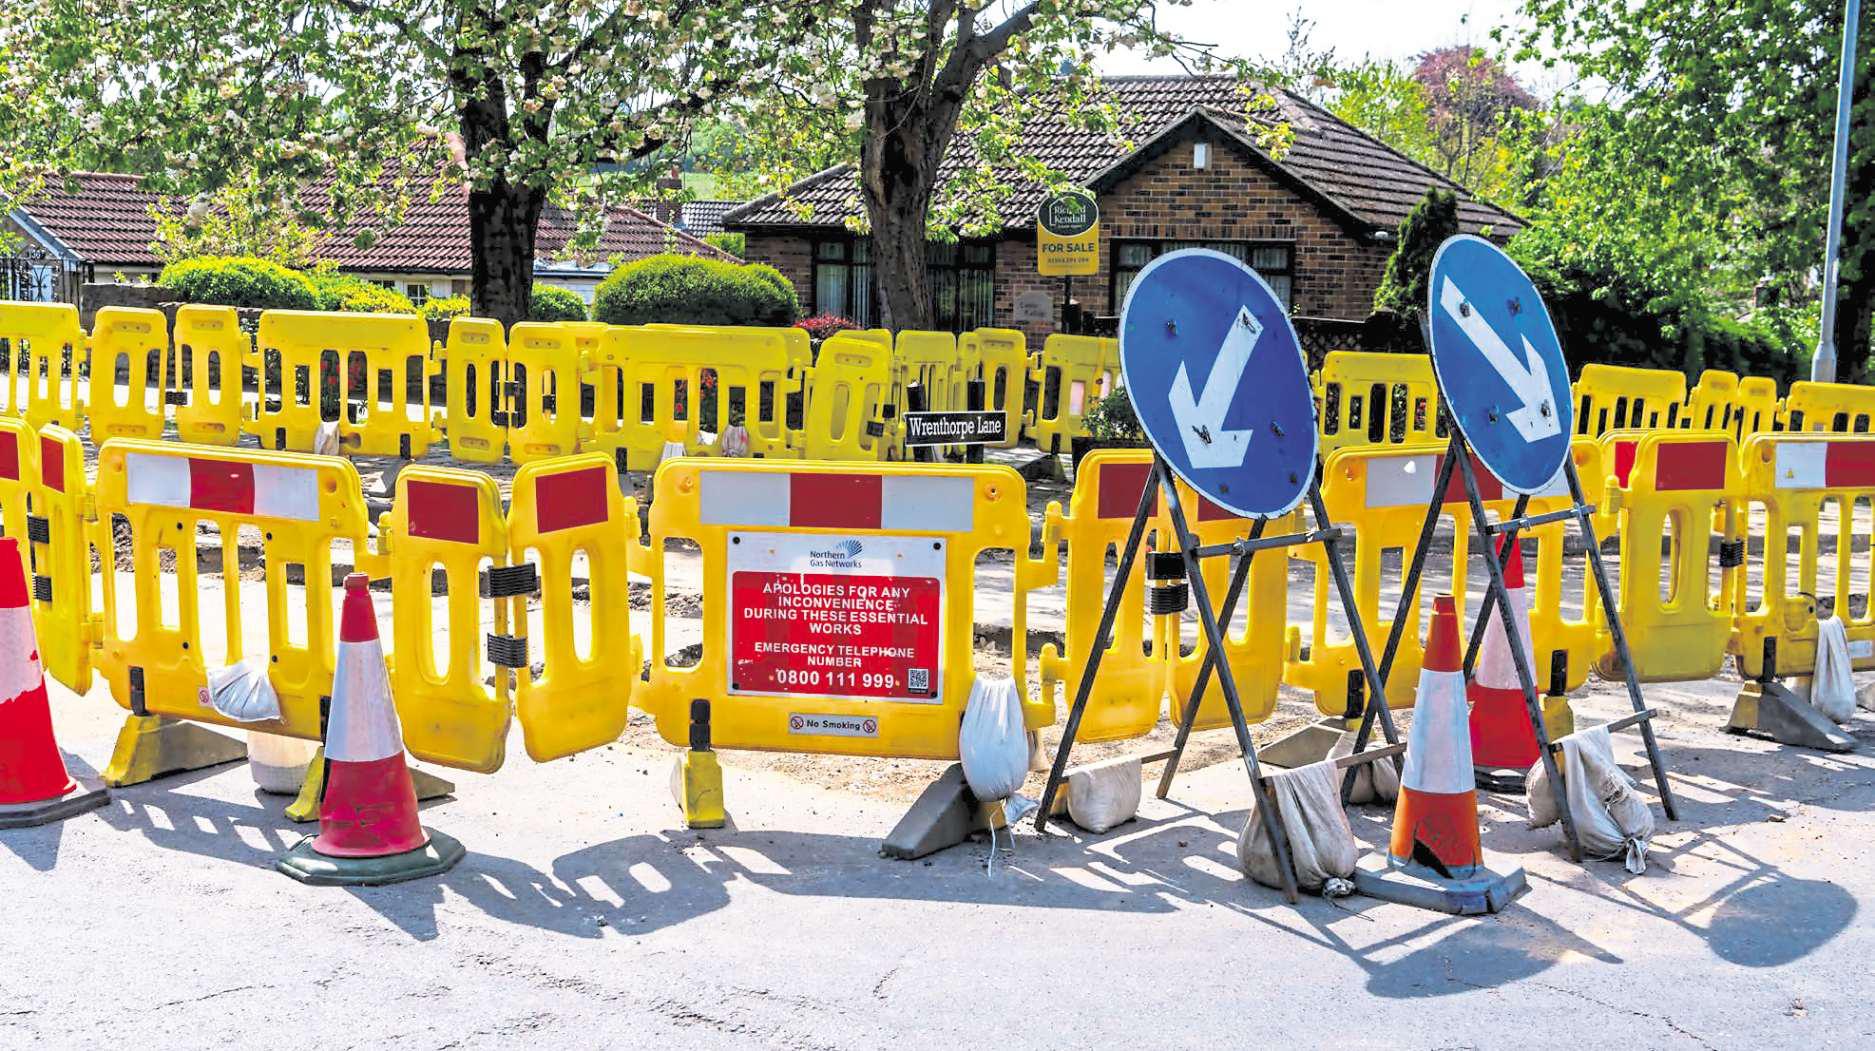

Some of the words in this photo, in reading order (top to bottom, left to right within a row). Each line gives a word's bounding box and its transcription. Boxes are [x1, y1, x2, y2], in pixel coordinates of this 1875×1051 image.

[1042, 243, 1063, 253] FOR
[1066, 242, 1095, 252] SALE
[909, 416, 975, 439] Wrenthorpe
[977, 416, 1001, 434] Lane
[810, 550, 845, 560] Northern
[825, 560, 862, 568] Networks
[762, 583, 845, 596] APOLOGIES
[849, 585, 877, 598] FOR
[881, 587, 911, 598] ANY
[778, 597, 894, 611] INCONVENIENCE
[744, 608, 797, 620] DURING
[801, 609, 847, 622] THESE
[850, 611, 928, 625] ESSENTIAL
[809, 622, 862, 635] WORKS
[754, 642, 835, 656] EMERGENCY
[838, 645, 914, 658] TELEPHONE
[807, 656, 862, 667] NUMBER
[777, 669, 820, 685] 0800
[826, 672, 855, 686] 111
[862, 673, 895, 688] 999
[806, 720, 819, 728] No
[822, 720, 861, 731] Smoking
